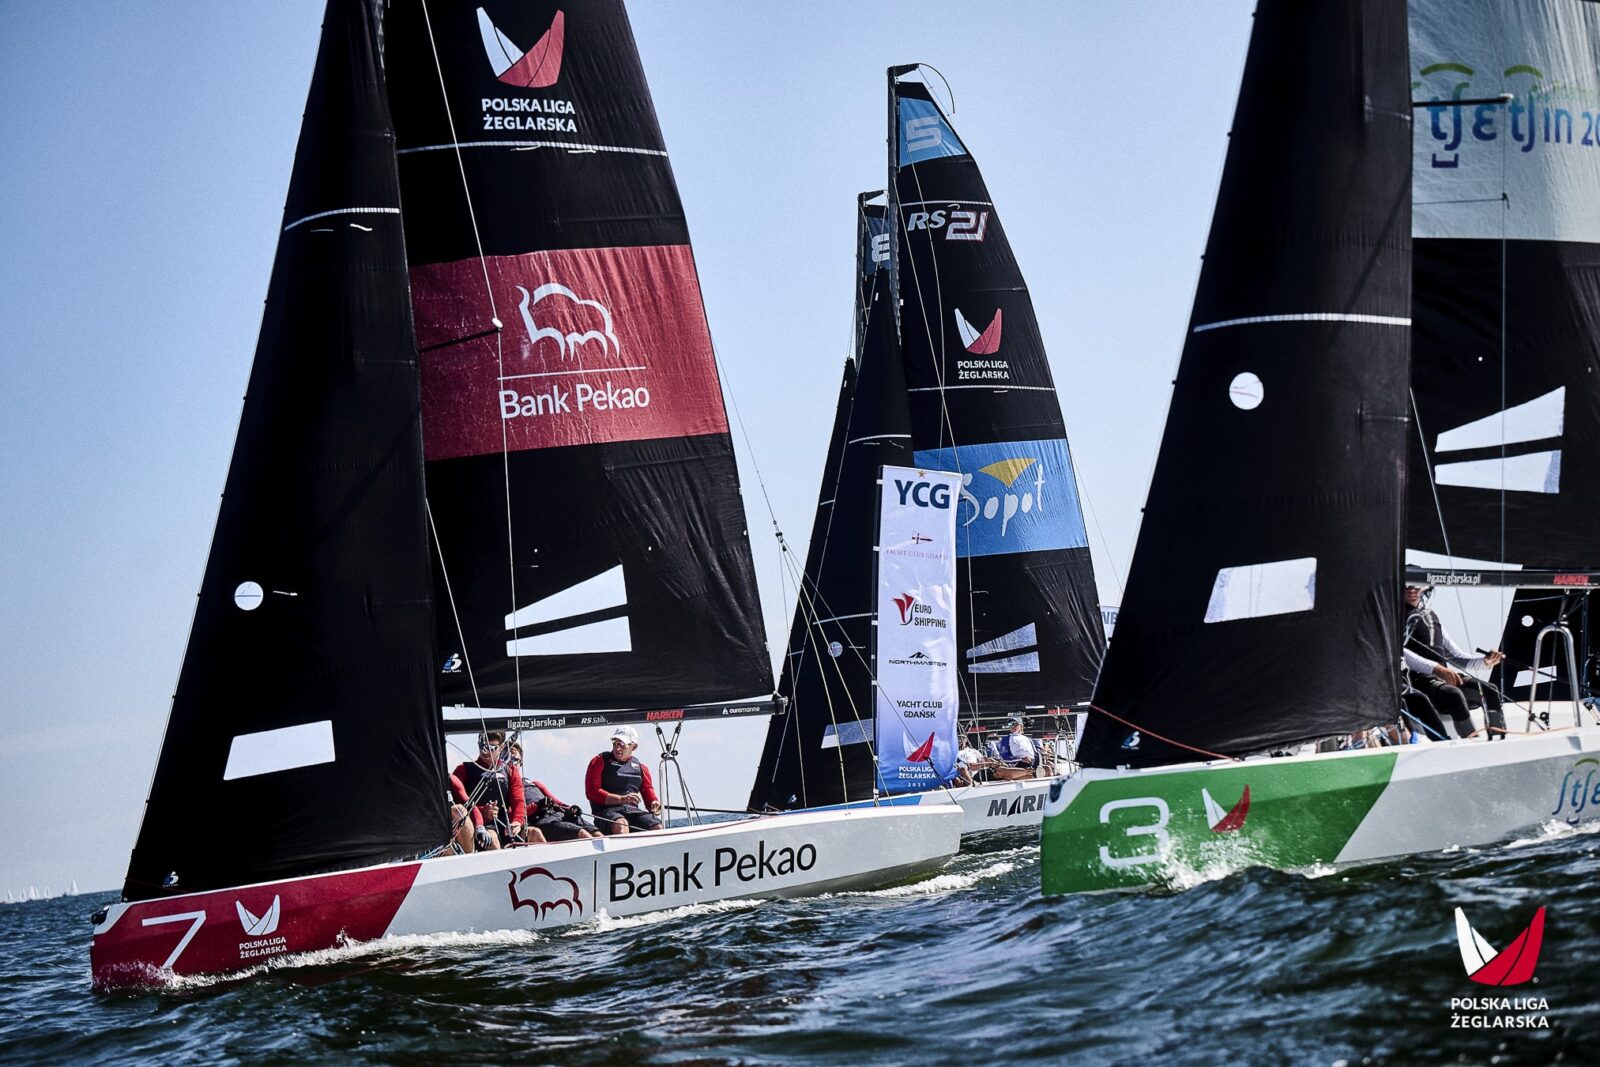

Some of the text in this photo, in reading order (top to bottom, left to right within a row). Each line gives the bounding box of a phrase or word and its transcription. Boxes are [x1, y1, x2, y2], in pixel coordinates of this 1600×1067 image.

[481, 98, 576, 115] POLSKA LIGA
[483, 113, 578, 133] ŻEGLARSKA
[905, 115, 941, 153] 5
[957, 360, 1009, 369] POLSKA LIGA
[958, 370, 1010, 379] ŻEGLARSKA
[498, 381, 650, 419] Bank Pekao
[894, 479, 950, 509] YCG
[961, 463, 1046, 537] Sopot
[1553, 575, 1590, 586] HARKEN
[914, 604, 932, 614] EURO
[914, 617, 947, 628] SHIPPING
[888, 659, 948, 667] NORTHMASTER
[897, 700, 943, 709] YACHT CLUB
[646, 709, 684, 720] HARKEN
[903, 709, 936, 718] GDAŃSK
[898, 765, 921, 773] POLSKA
[987, 793, 1048, 818] MARI
[1099, 796, 1171, 868] 3
[609, 840, 817, 902] Bank Pekao
[142, 910, 207, 969] 7
[239, 936, 287, 951] POLSKA LIGA
[240, 945, 288, 959] ŻEGLARSKA
